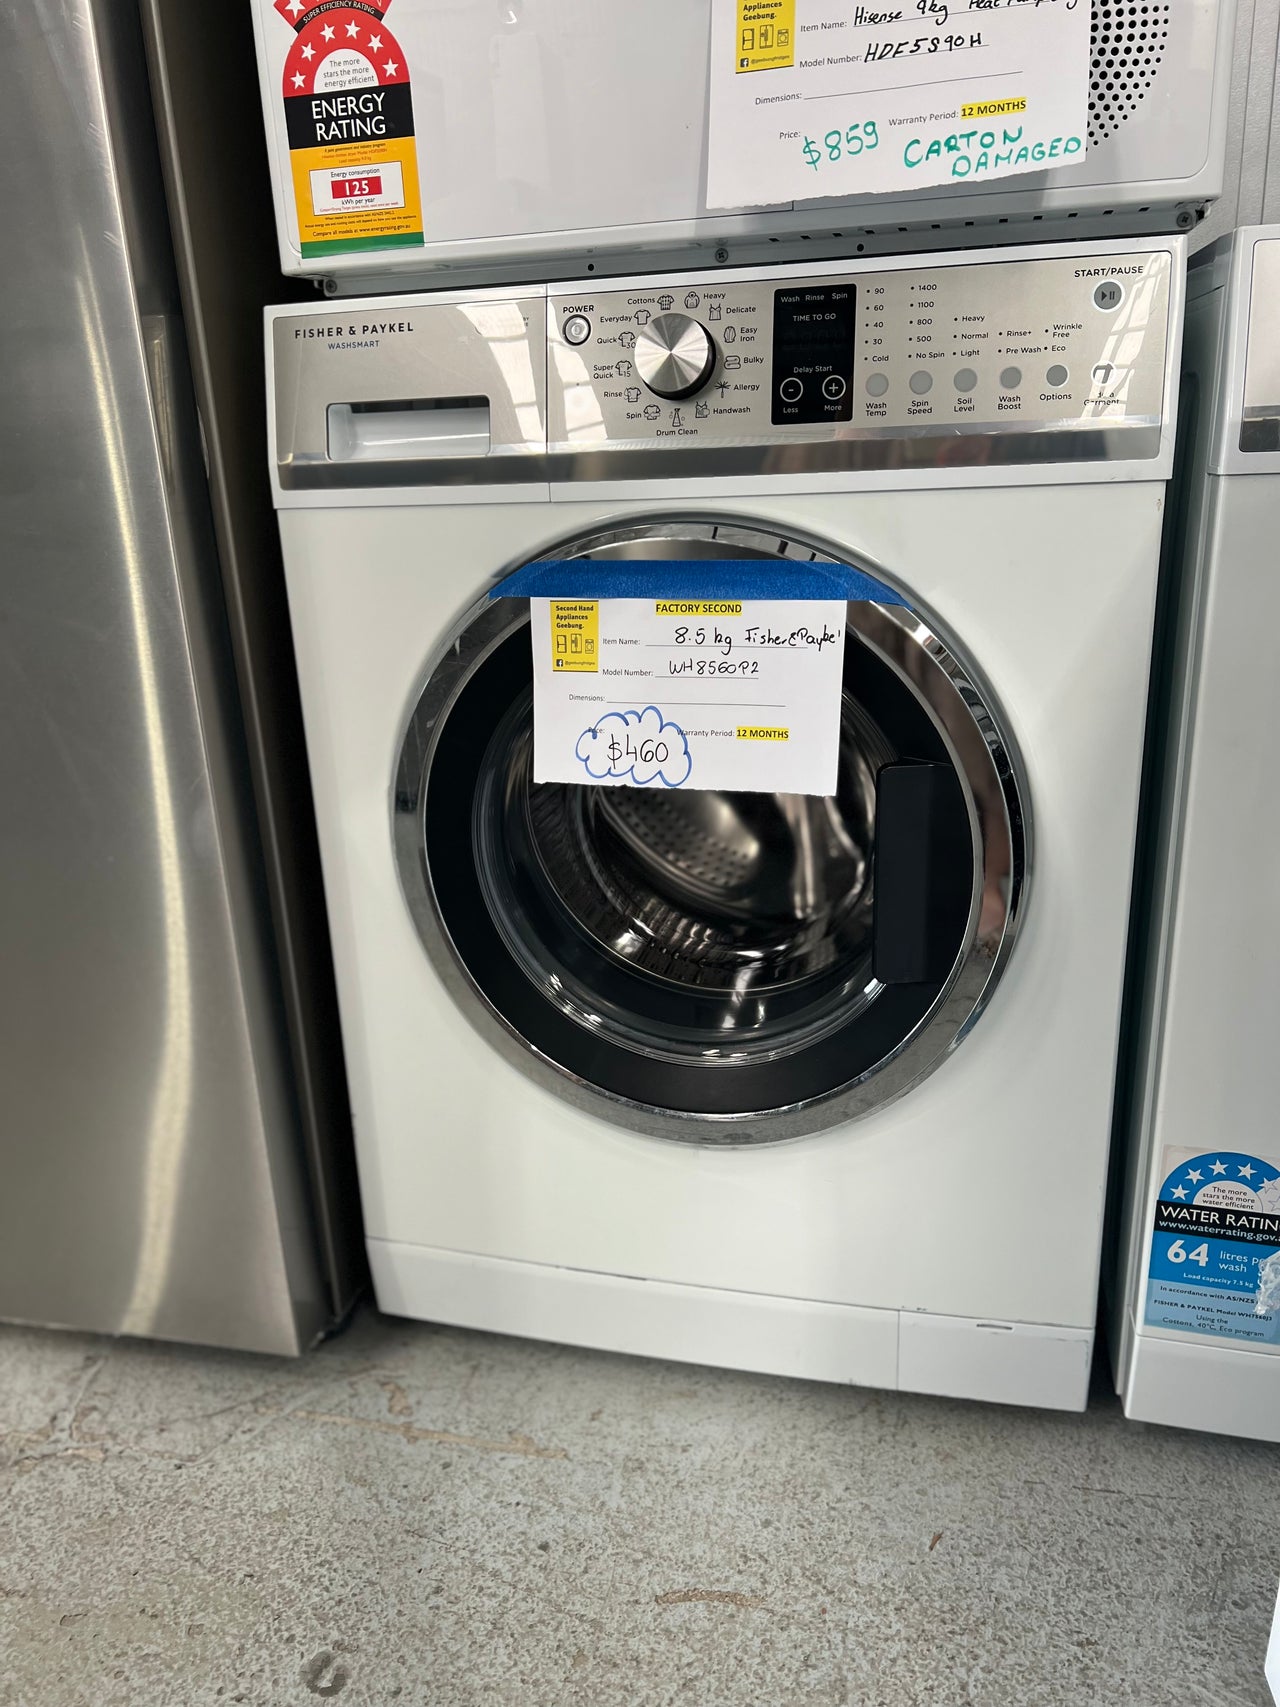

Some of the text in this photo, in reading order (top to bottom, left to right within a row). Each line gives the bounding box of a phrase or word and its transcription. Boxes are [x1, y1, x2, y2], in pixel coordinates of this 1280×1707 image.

[303, 0, 375, 23] SUPER EFFICIENCY RATING
[743, 1, 783, 12] Appliances
[743, 12, 777, 21] Geebung.
[800, 23, 819, 32] Item
[821, 20, 847, 31] Name:
[853, 6, 903, 26] Hisense
[343, 58, 360, 66] more
[800, 58, 825, 68] Model
[827, 53, 862, 65] Number:
[323, 69, 339, 79] stars
[352, 66, 370, 74] more
[324, 75, 374, 88] energy efficient
[755, 92, 802, 105] Dimensions:
[311, 92, 385, 119] ENERGY
[888, 99, 1026, 127] Warranty Period: 12 MONTHS
[316, 116, 386, 141] RATING
[779, 130, 800, 140] Price:
[803, 120, 879, 171] $859
[903, 125, 1023, 168] CARTON
[951, 136, 1082, 178] DAMAGED
[348, 168, 380, 177] consumption
[345, 180, 369, 196] 125
[1074, 266, 1144, 278] START/PAUSE
[918, 283, 937, 291] 1400
[703, 292, 726, 300] Heavy
[781, 292, 848, 303] Wash Rinse Spin
[627, 297, 656, 306] Cottons
[562, 304, 595, 313] POWER
[726, 306, 757, 314] Delicate
[873, 304, 884, 312] 60
[600, 314, 633, 324] Everyday
[873, 321, 884, 329] 40
[294, 322, 414, 339] FISHER & PAYKEL
[740, 326, 758, 335] Easy
[596, 336, 618, 345] Quick
[740, 334, 755, 342] Iron
[961, 332, 989, 340] Normal
[328, 340, 380, 350] WASHSMART
[928, 351, 945, 359] Spin
[960, 349, 980, 357] Light
[1006, 346, 1042, 355] Pre Wash
[743, 356, 764, 364] Bulky
[593, 363, 614, 373] Super
[793, 366, 814, 374] Delay
[593, 371, 614, 380] Quick
[733, 383, 760, 392] Allergy
[603, 390, 623, 398] Rinse
[1039, 393, 1072, 401] Options
[911, 400, 929, 408] Spin
[957, 397, 973, 405] Soil
[713, 406, 751, 415] Handwash
[783, 406, 799, 414] Less
[866, 409, 887, 417] Temp
[907, 407, 933, 415] Speed
[626, 411, 642, 420] Spin
[656, 427, 698, 437] Drum Clean
[656, 603, 742, 613] FACTORY SECOND
[675, 626, 705, 645] 8.5
[714, 627, 732, 655] kg
[624, 669, 654, 677] Number:
[568, 693, 606, 702] Dimensions:
[676, 729, 708, 737] Warranty
[749, 730, 789, 739] MONTHS
[607, 733, 669, 770] $460
[1212, 1186, 1226, 1194] The
[1224, 1200, 1254, 1210] efficient
[1235, 1196, 1255, 1204] more
[1160, 1205, 1280, 1232] WATER RATIN
[1167, 1239, 1209, 1267] 64
[1220, 1250, 1248, 1263] litres
[1218, 1262, 1247, 1273] wash
[1202, 1275, 1231, 1285] capacity
[1232, 1279, 1243, 1287] 7.5
[1168, 1286, 1207, 1297] accordance
[1209, 1292, 1225, 1300] with
[1226, 1295, 1255, 1304] AS/NZS
[1153, 1299, 1178, 1307] FISHER
[1187, 1304, 1215, 1313] PAYKEL
[1196, 1314, 1215, 1324] Using
[1234, 1328, 1265, 1338] program
